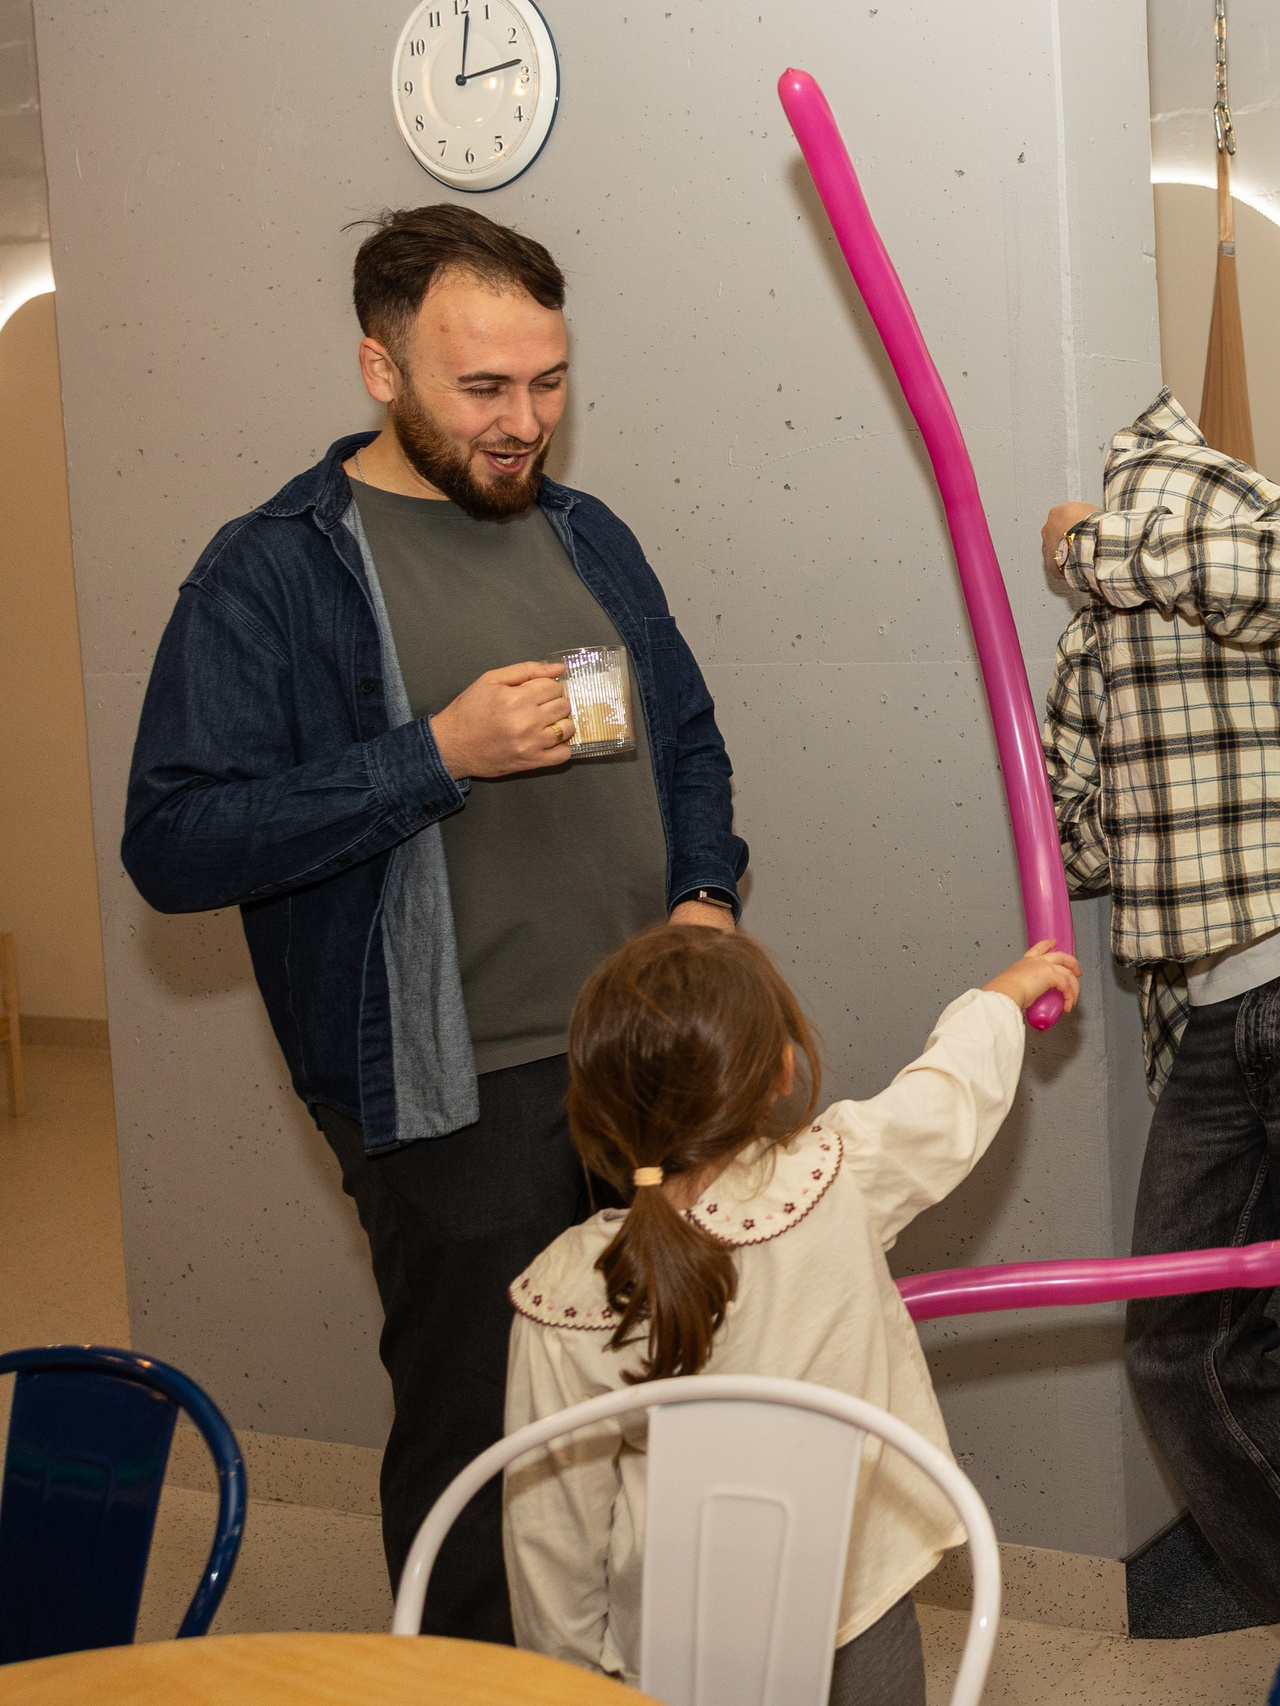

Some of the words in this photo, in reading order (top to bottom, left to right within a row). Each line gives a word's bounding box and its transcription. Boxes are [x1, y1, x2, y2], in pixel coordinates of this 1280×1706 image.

[453, 0, 470, 16] 12
[485, 4, 491, 20] 1
[429, 11, 442, 28] 11
[507, 27, 517, 44] 2
[410, 39, 426, 57] 10
[520, 66, 531, 84] 3
[404, 81, 414, 98] 9
[513, 105, 524, 122] 4
[415, 114, 425, 132] 8
[438, 140, 447, 157] 7
[493, 135, 504, 153] 5
[465, 147, 475, 164] 6
